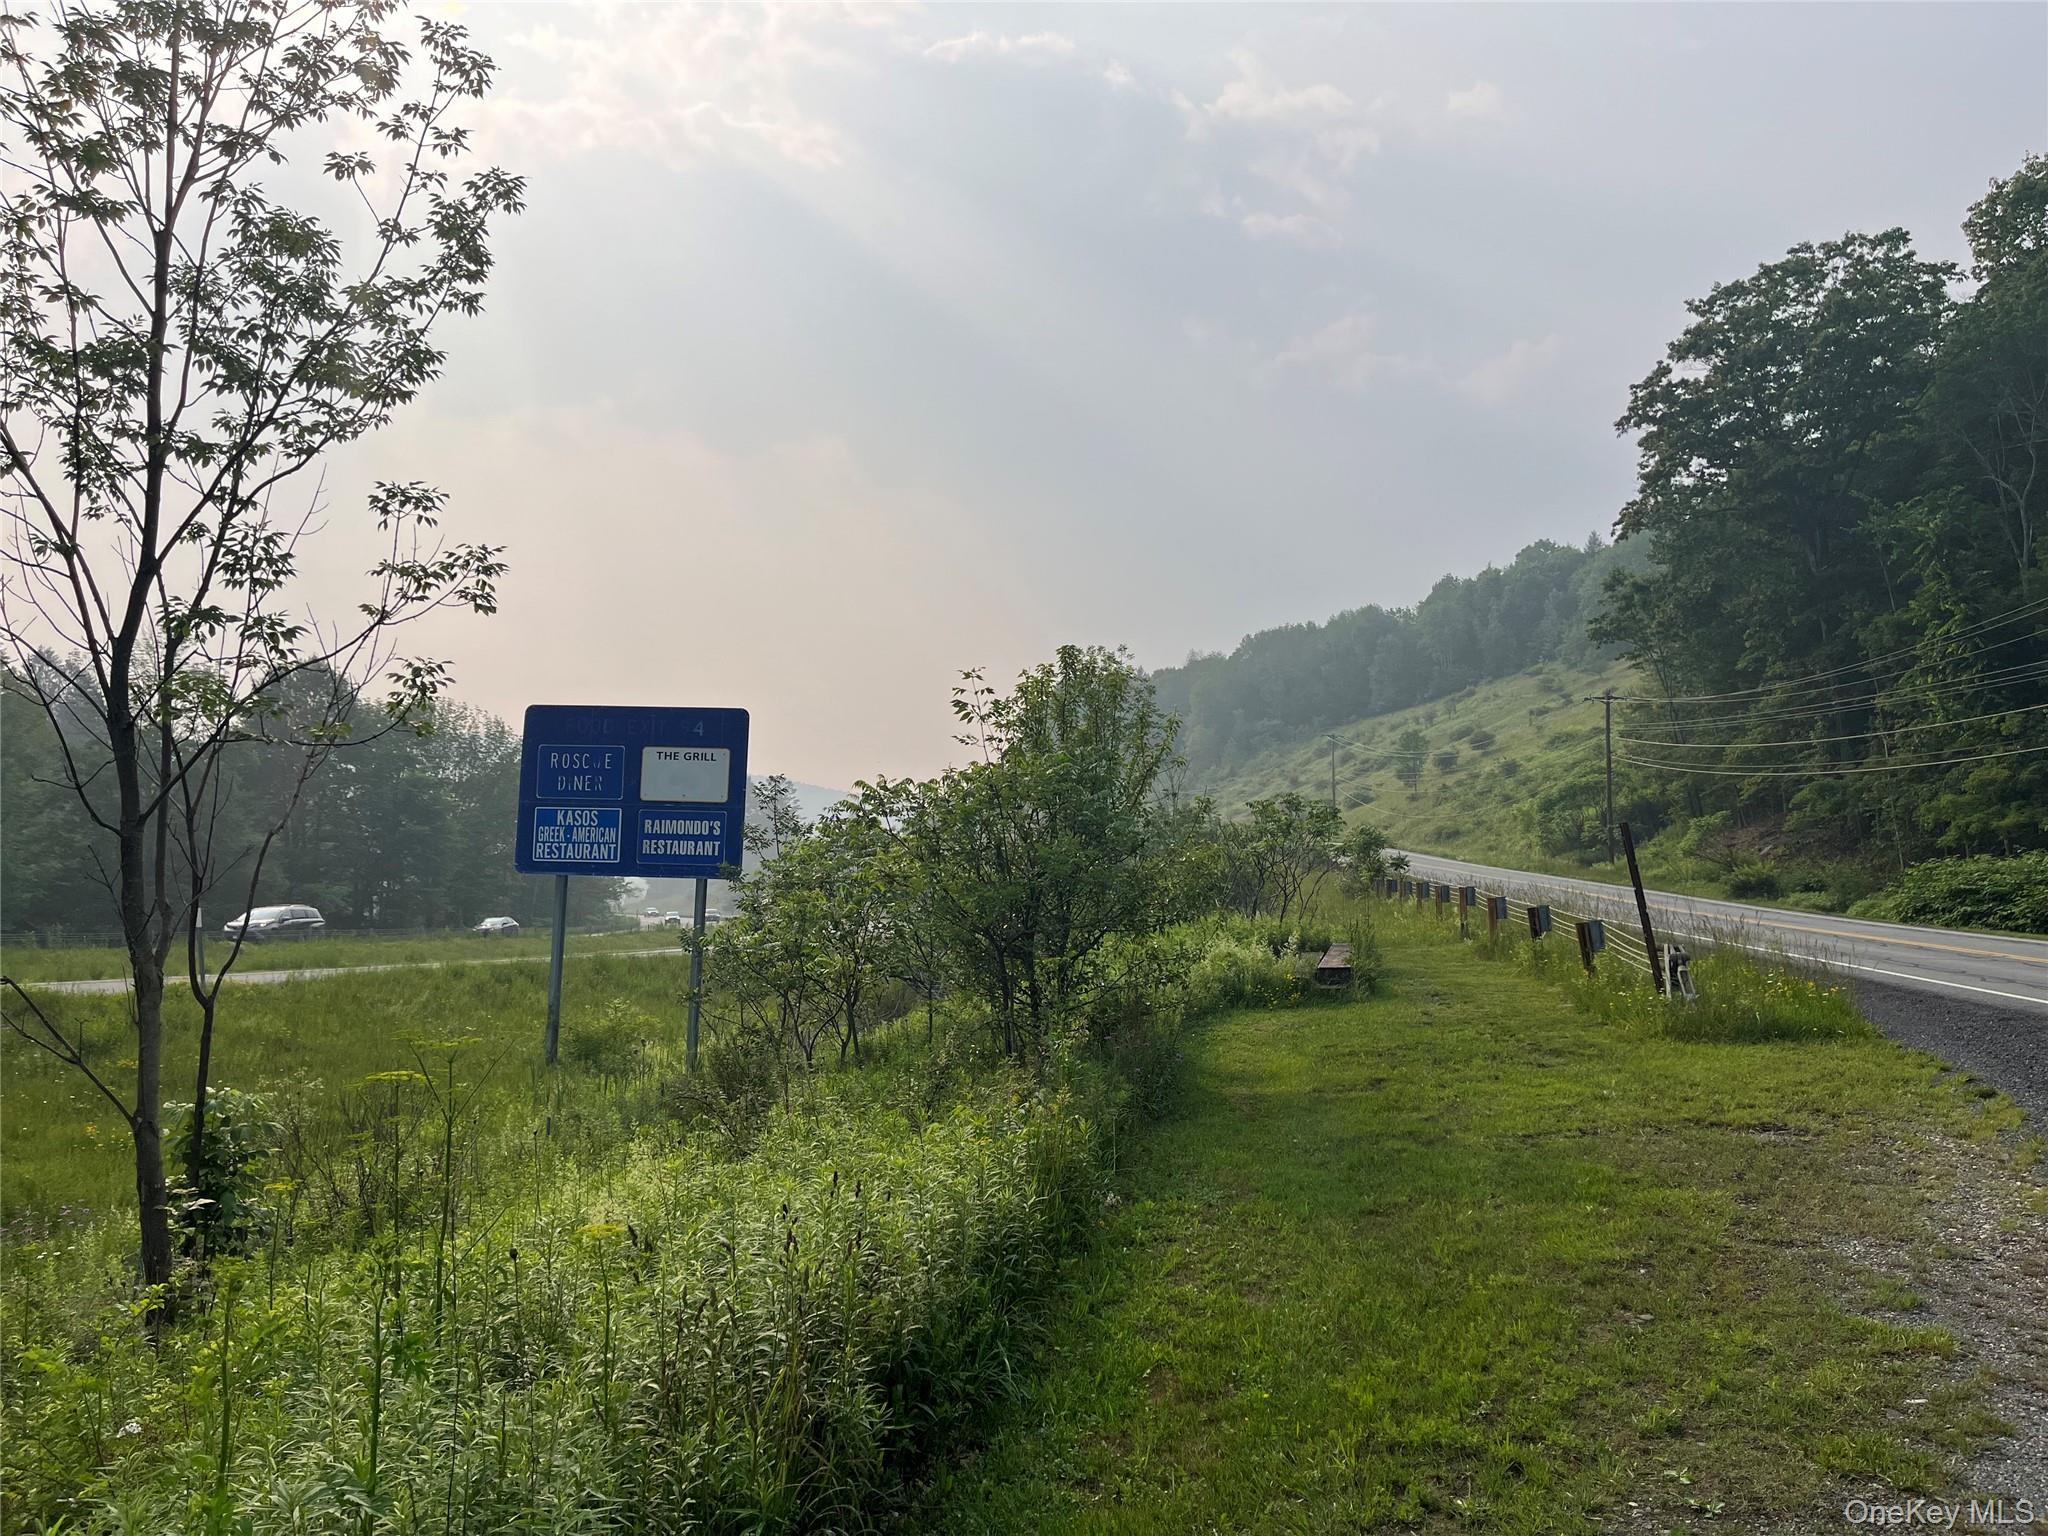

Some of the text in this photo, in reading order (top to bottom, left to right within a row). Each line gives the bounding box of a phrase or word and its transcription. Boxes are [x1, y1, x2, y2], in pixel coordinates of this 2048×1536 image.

[657, 751, 717, 762] THE GRILL
[556, 809, 599, 826] KASOS
[644, 819, 721, 836] RAIMONDO'S
[535, 843, 617, 860] RESTAURANT
[642, 839, 721, 856] RESTAURANT
